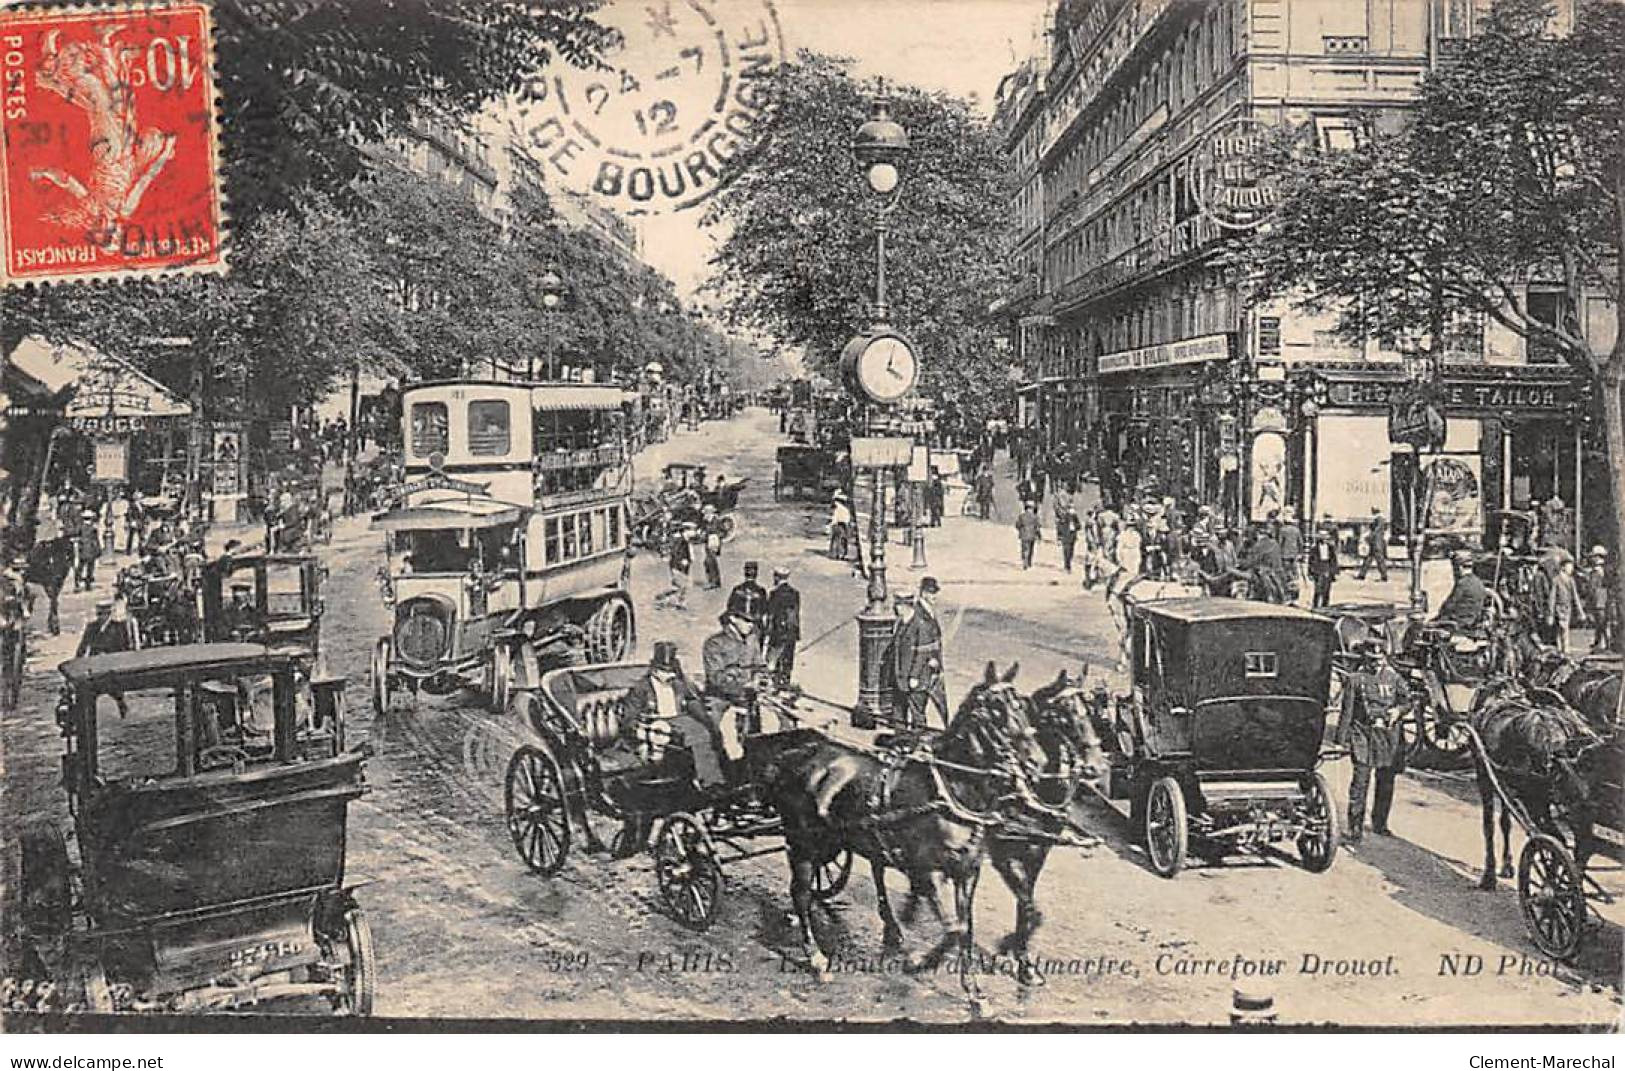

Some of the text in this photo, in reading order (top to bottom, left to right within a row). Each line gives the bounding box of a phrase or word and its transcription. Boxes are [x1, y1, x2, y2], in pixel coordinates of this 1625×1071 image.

[4, 35, 27, 120] POSTES
[592, 19, 774, 202] BOURGOGNE
[633, 99, 679, 137] 12
[1214, 135, 1261, 156] HIGH
[1213, 184, 1275, 208] TAILOR
[1475, 387, 1555, 406] TAILOR
